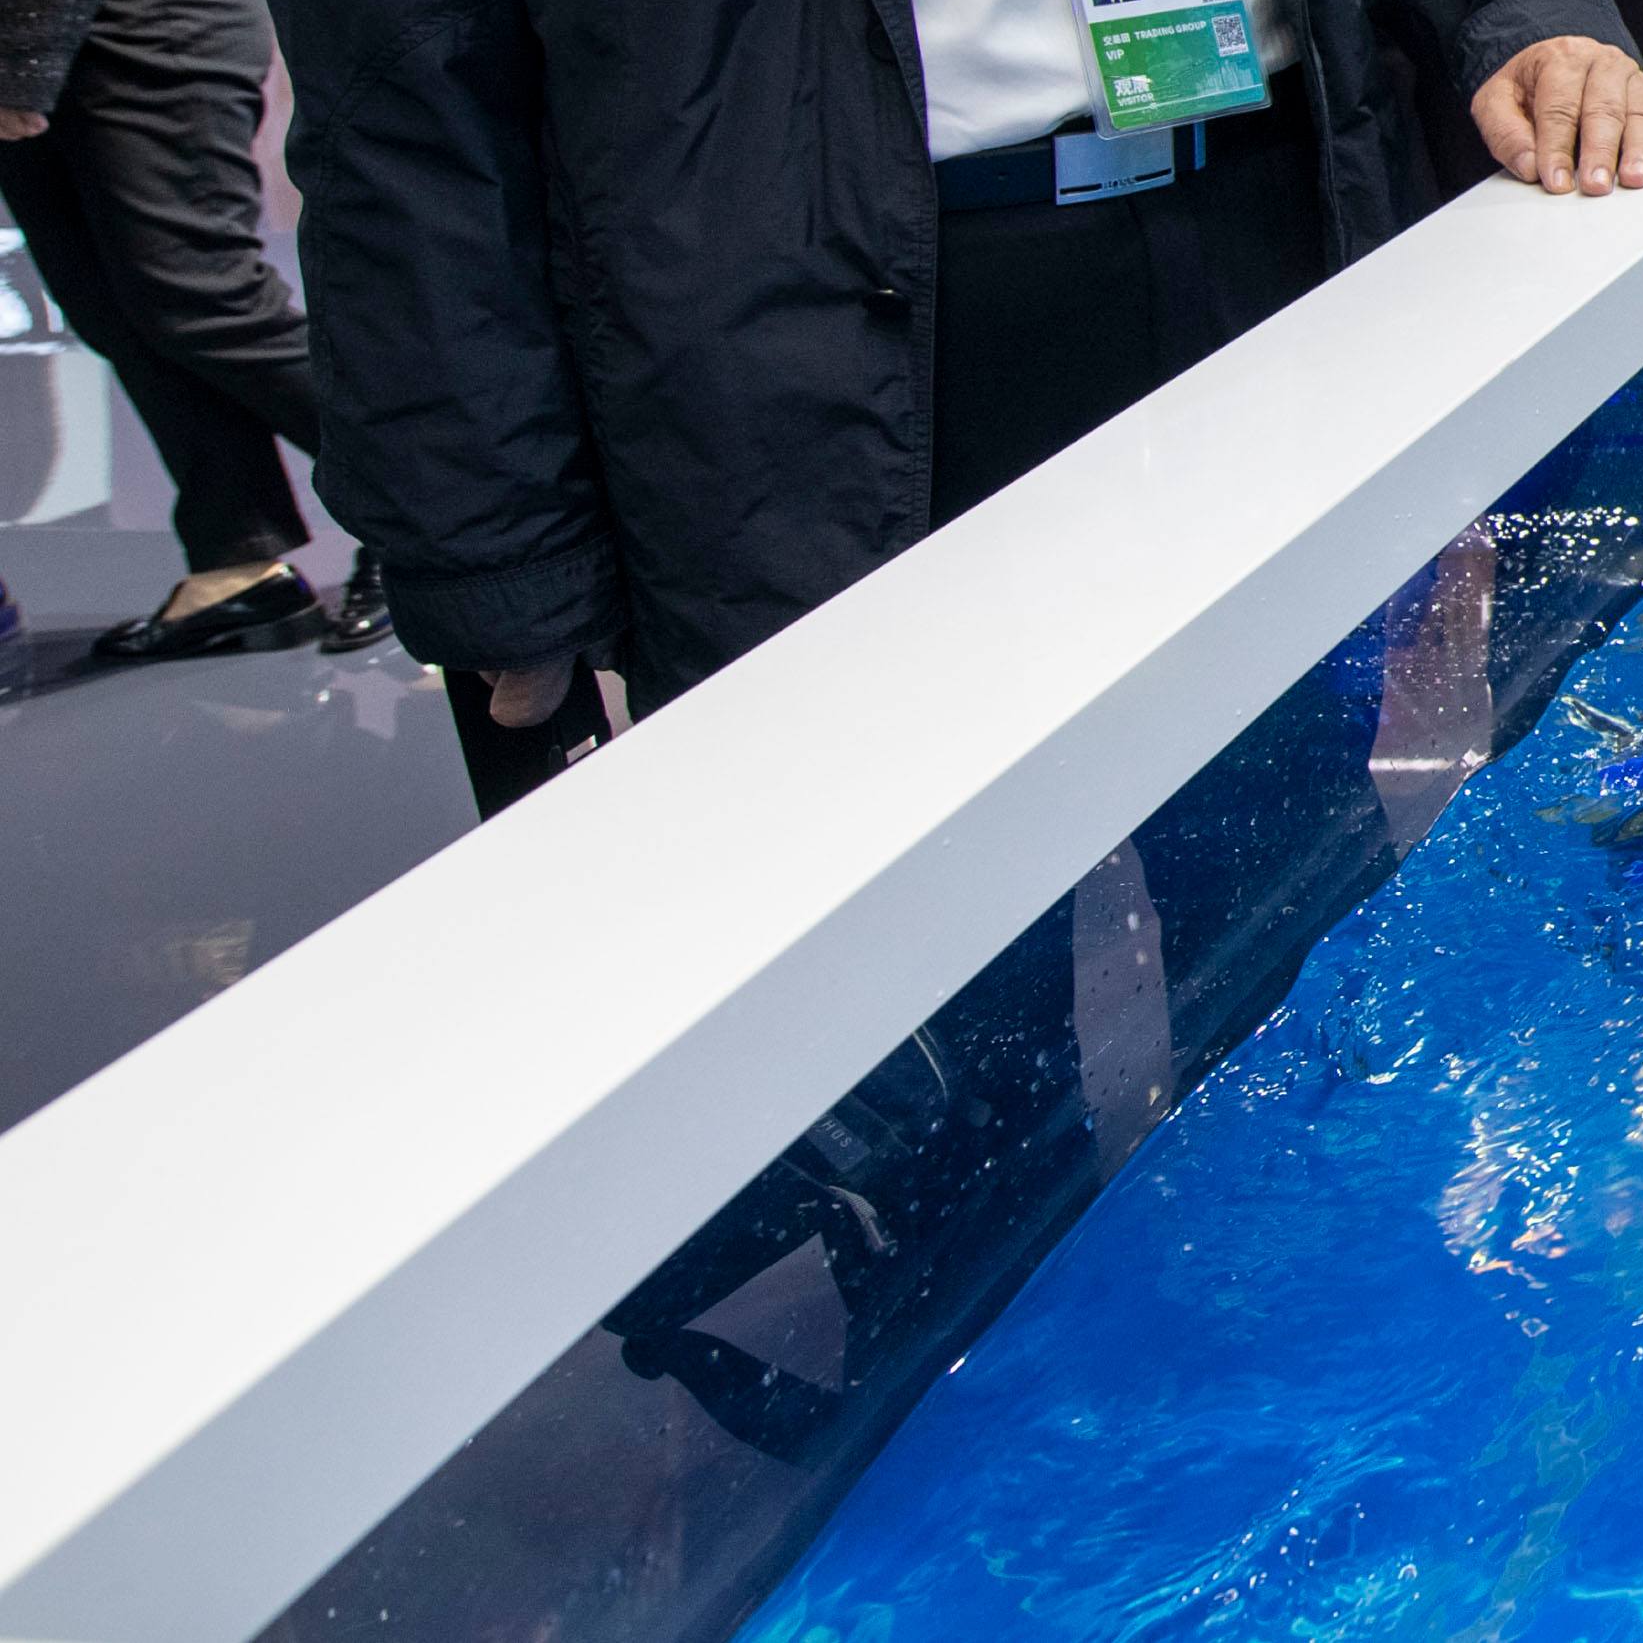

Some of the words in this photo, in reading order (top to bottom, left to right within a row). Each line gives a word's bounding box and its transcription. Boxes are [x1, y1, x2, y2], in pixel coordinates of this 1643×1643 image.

[1134, 27, 1175, 41] TRADING
[1175, 20, 1208, 34] GROUP
[1105, 48, 1125, 62] VIP
